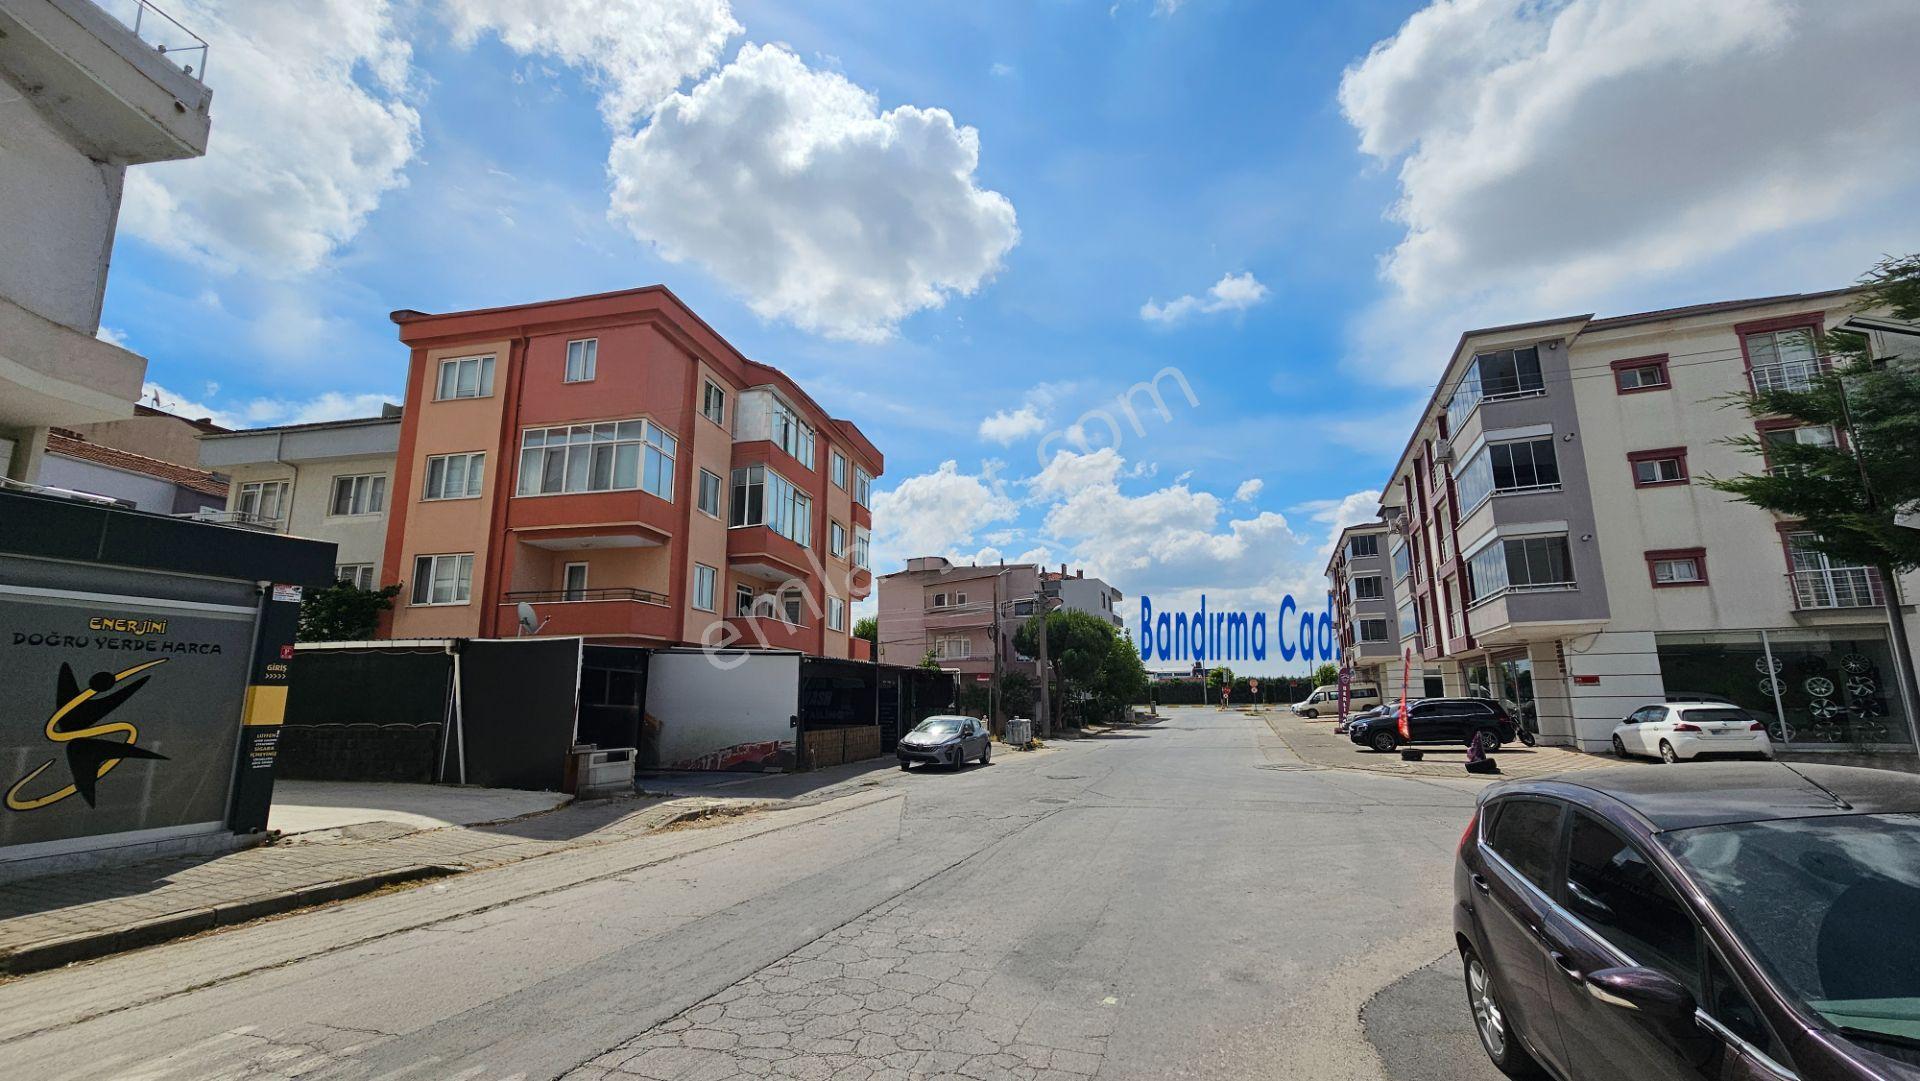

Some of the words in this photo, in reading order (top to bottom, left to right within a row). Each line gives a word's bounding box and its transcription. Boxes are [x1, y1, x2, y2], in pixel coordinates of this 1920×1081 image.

[88, 617, 168, 636] ENERJİNİ
[12, 631, 90, 648] DOĞRU
[94, 636, 157, 652] YERDE
[161, 641, 222, 656] HARCA
[267, 662, 288, 673] GİRİŞ
